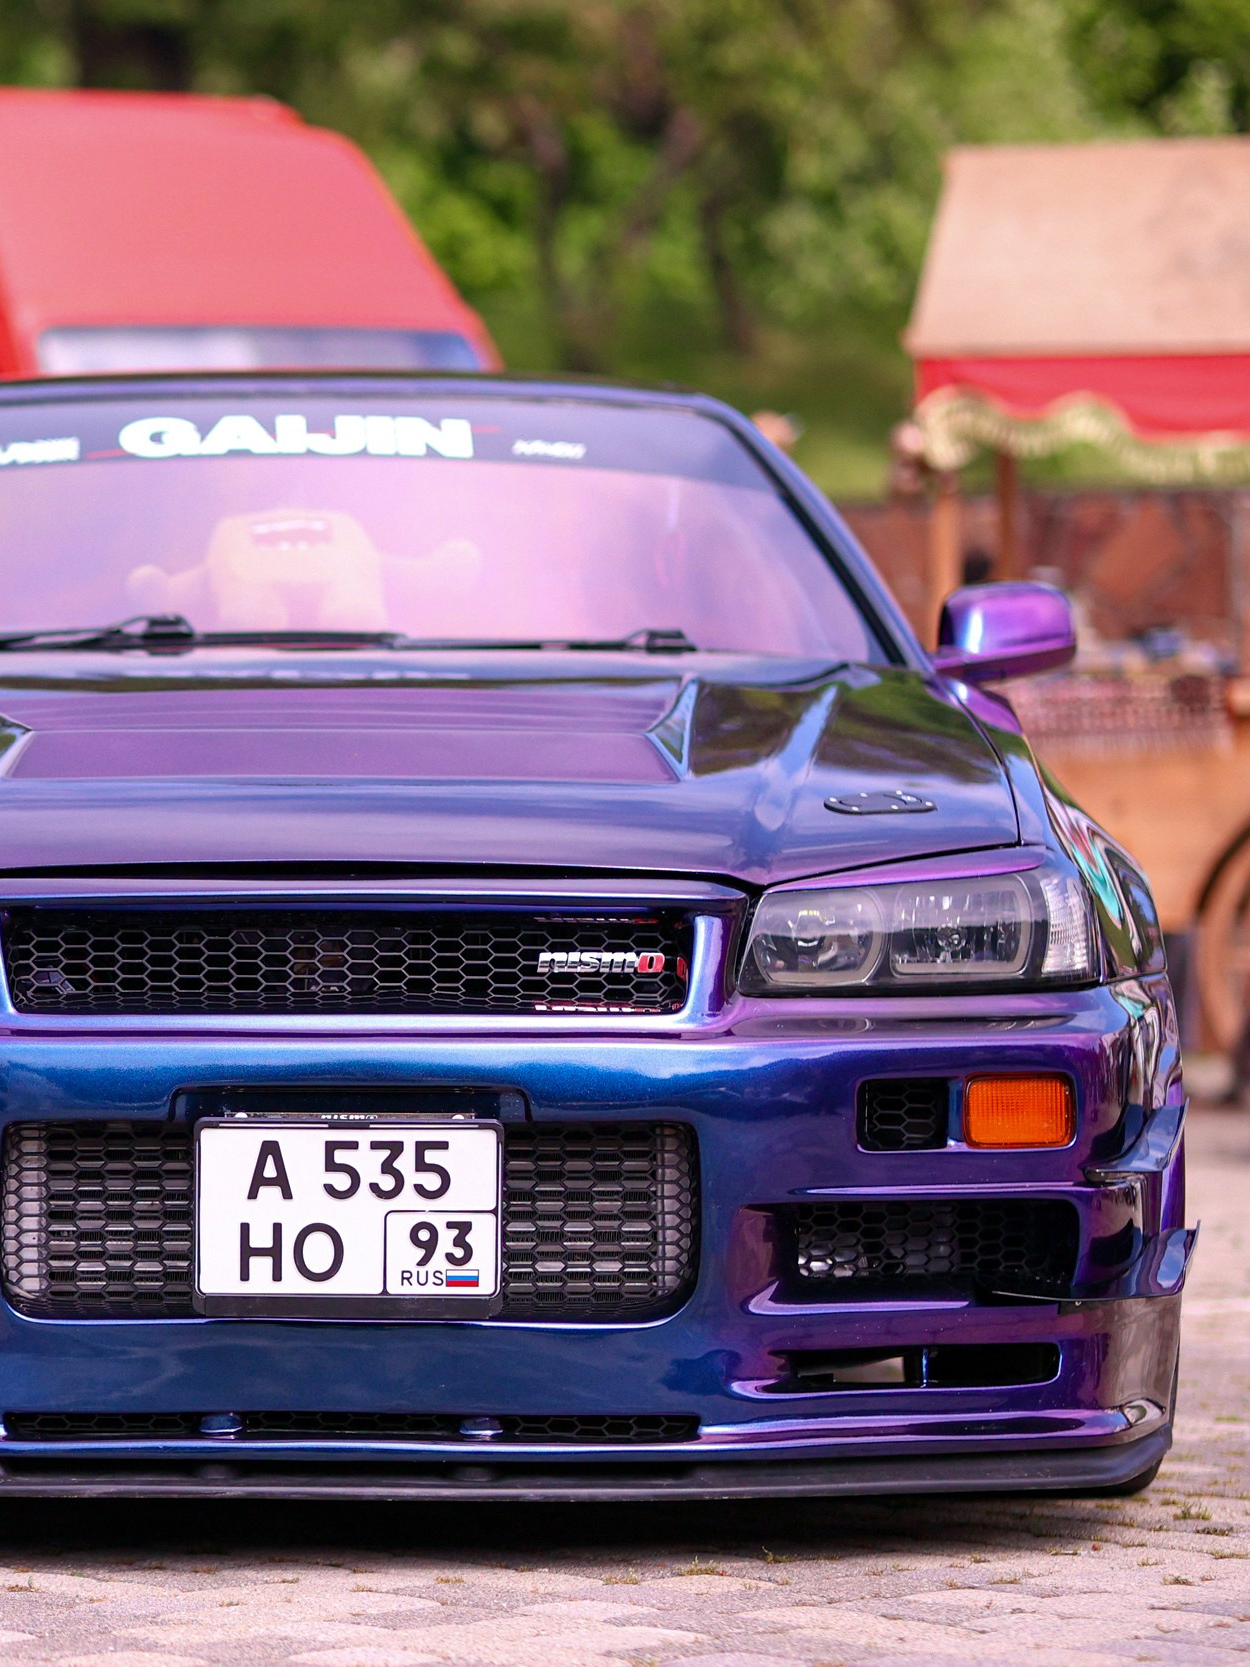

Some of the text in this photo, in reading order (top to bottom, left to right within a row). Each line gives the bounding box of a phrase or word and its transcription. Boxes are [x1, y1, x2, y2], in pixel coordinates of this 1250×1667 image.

[119, 415, 474, 459] GAIJIN
[247, 1140, 451, 1200] A 535
[409, 1221, 474, 1267] 93
[400, 1270, 444, 1286] RUS
